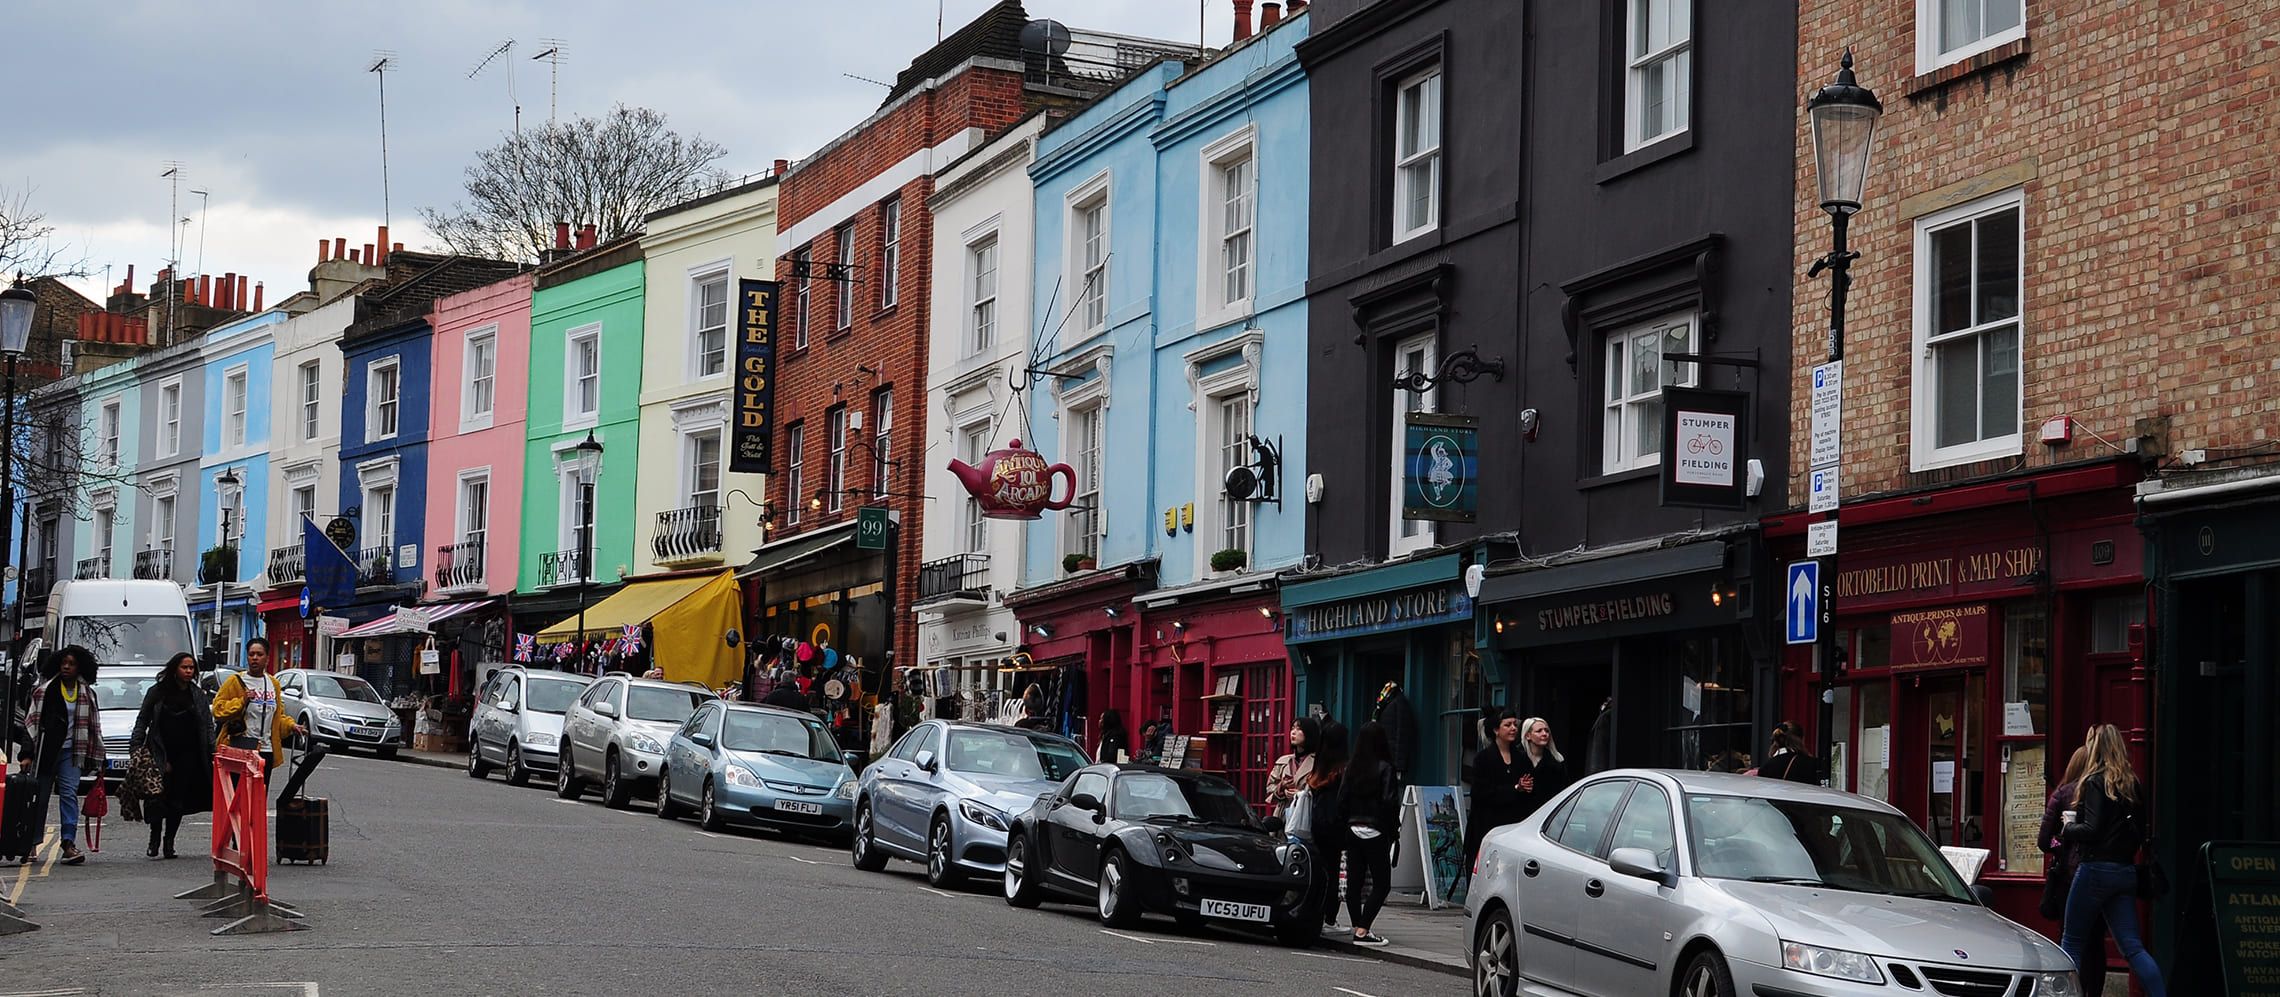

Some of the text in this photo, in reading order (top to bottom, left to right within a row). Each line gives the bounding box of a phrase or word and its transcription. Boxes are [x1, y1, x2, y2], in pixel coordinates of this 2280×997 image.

[746, 291, 769, 344] THE
[741, 356, 766, 428] GOLD
[1682, 418, 1729, 430] STUMPER
[992, 454, 1048, 478] ANTIQUE
[1682, 459, 1728, 470] FIELDING
[1020, 470, 1036, 486] 101
[995, 483, 1048, 502] ARCADE
[862, 519, 882, 536] 99
[1837, 565, 1907, 598] ORTOBELLO
[1911, 558, 1953, 590] PRINT
[1958, 563, 1967, 584] &
[1970, 554, 2001, 581] MAP
[1307, 588, 1447, 633] HIGHLAND STORE
[1538, 604, 1599, 631] STUMPER
[1607, 593, 1673, 622] FIELDING
[1891, 605, 1986, 624] ANTIQUE PRINTS & MAPS
[780, 801, 817, 813] YR51 FLJ
[2231, 856, 2277, 871] OPEN
[1207, 901, 1266, 919] YC53 UFU
